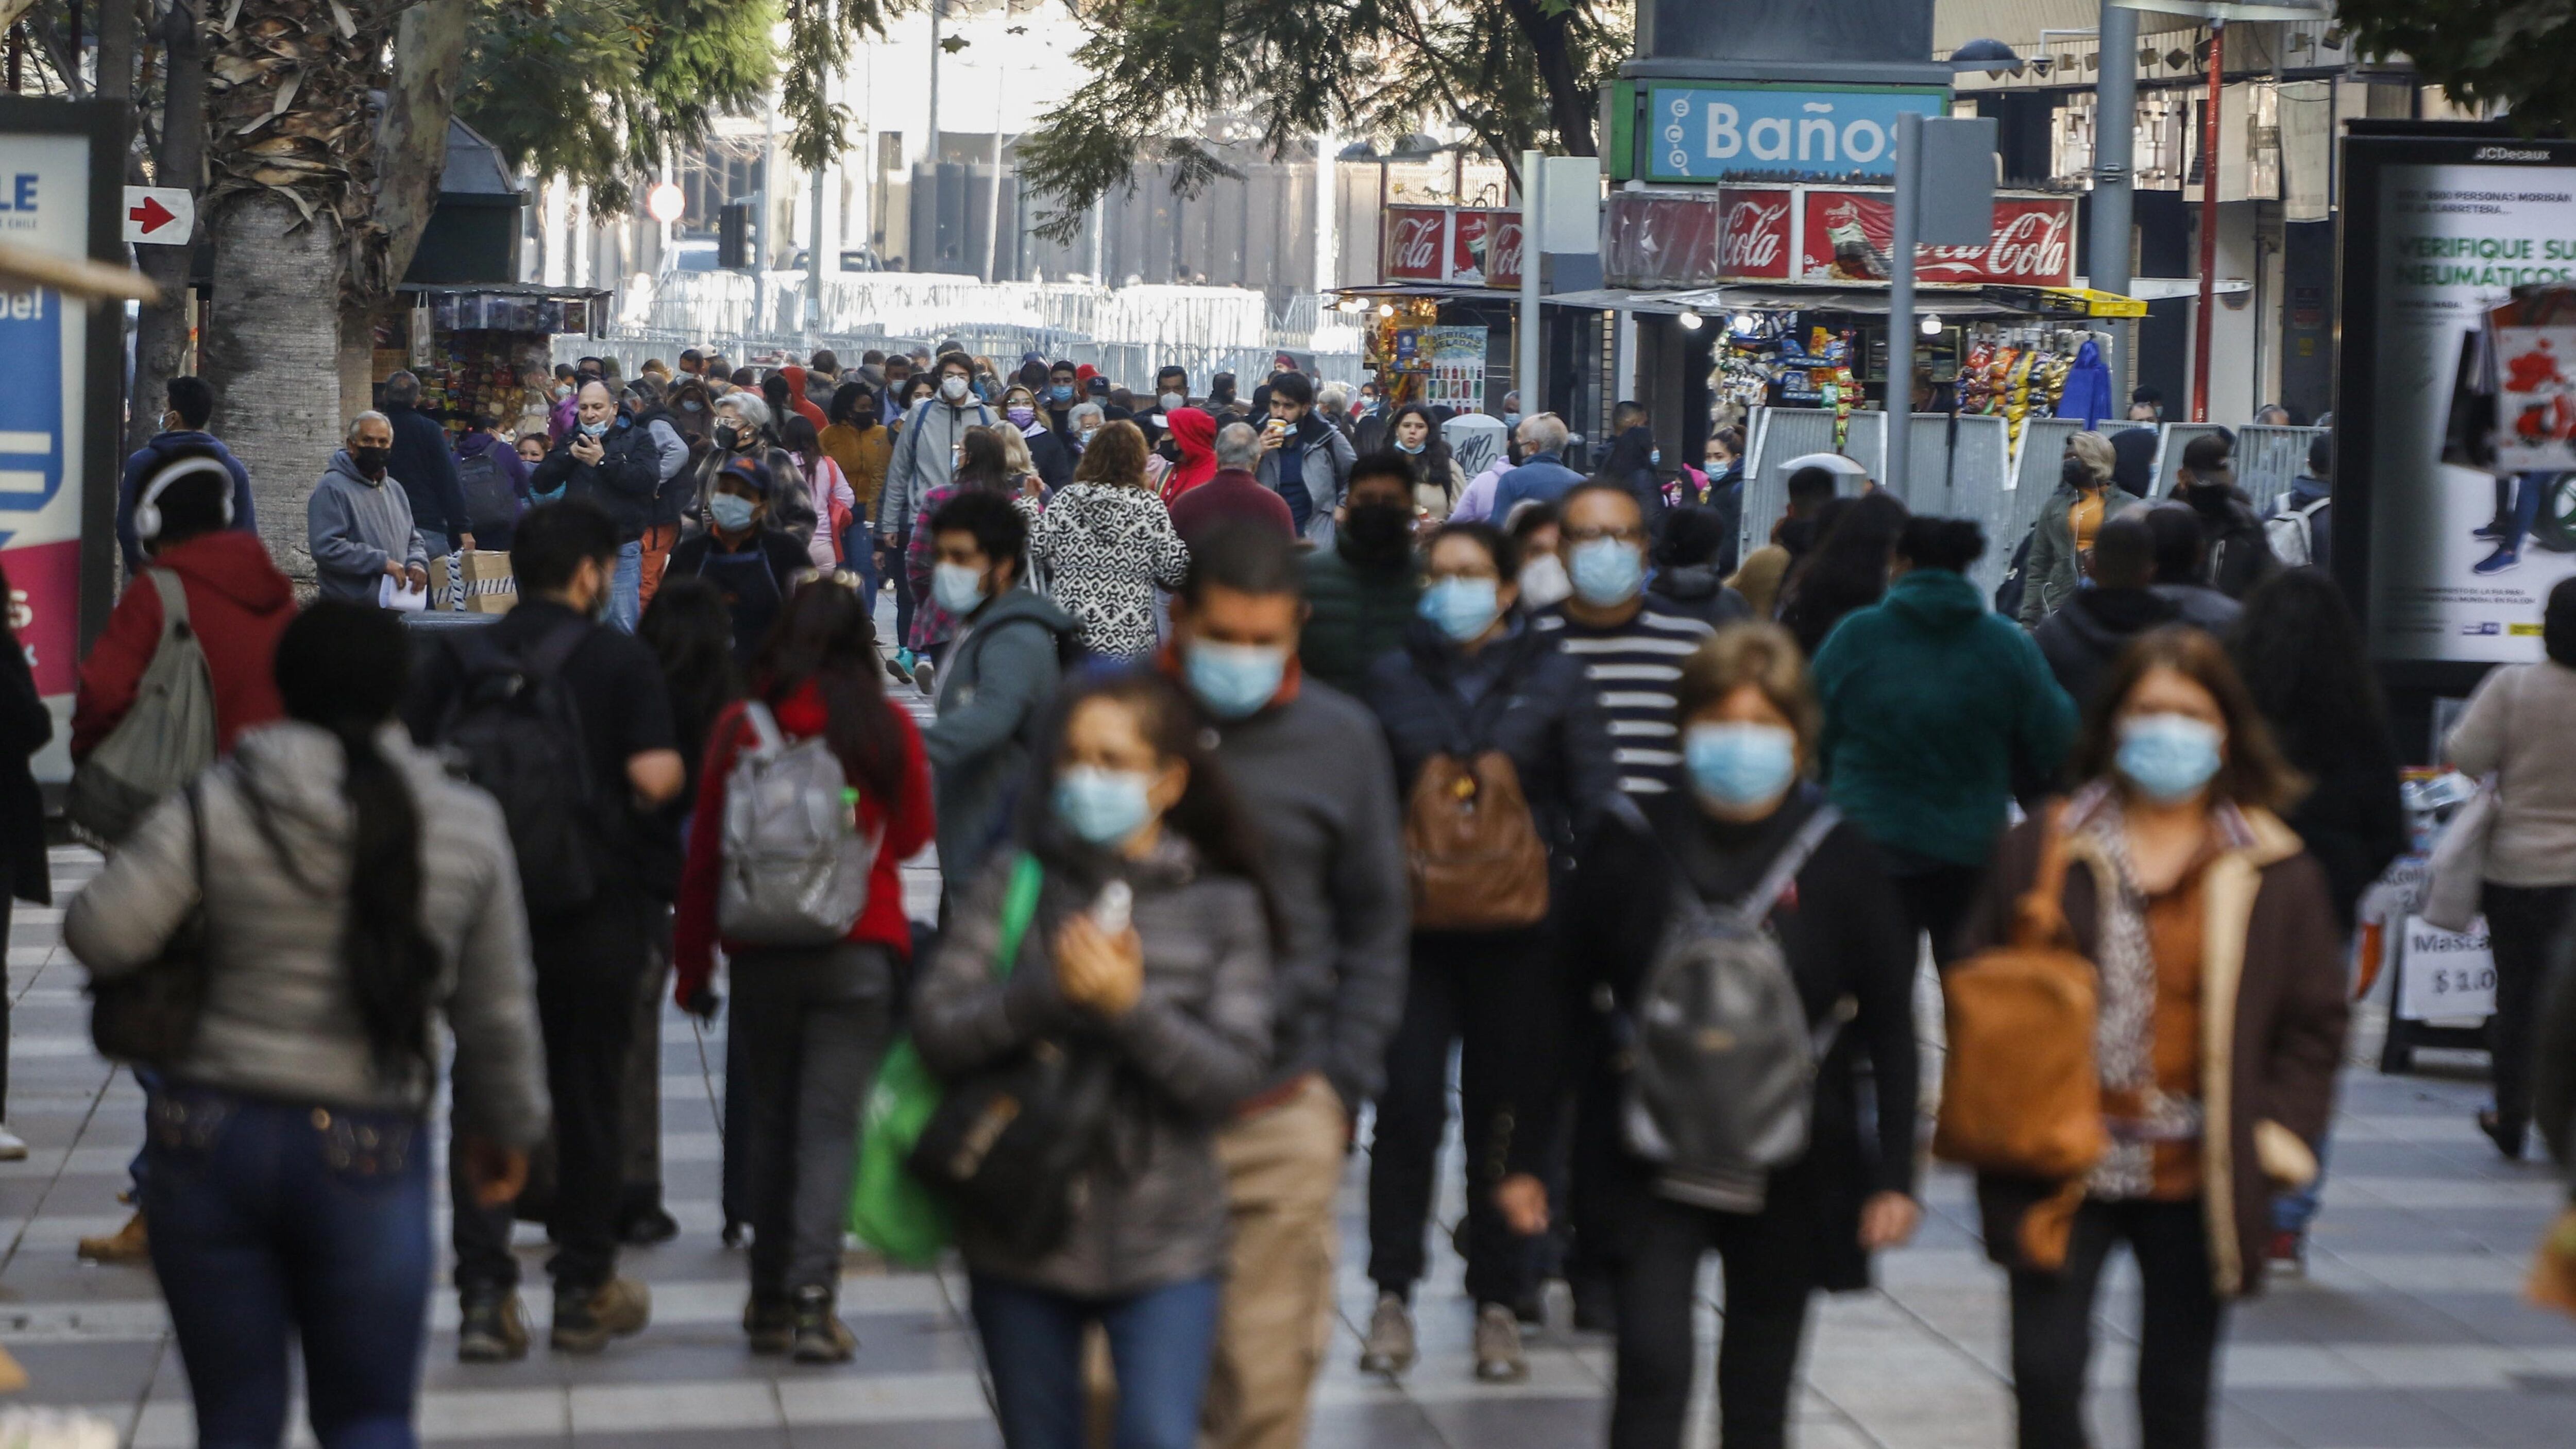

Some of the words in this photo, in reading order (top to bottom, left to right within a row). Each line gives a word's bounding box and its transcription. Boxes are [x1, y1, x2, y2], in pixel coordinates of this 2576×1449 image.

[1706, 103, 1896, 163] Baño
[2477, 147, 2550, 161] JCDecaux
[2455, 192, 2515, 201] PERSONAS
[2399, 238, 2534, 259] VERIFIQUE
